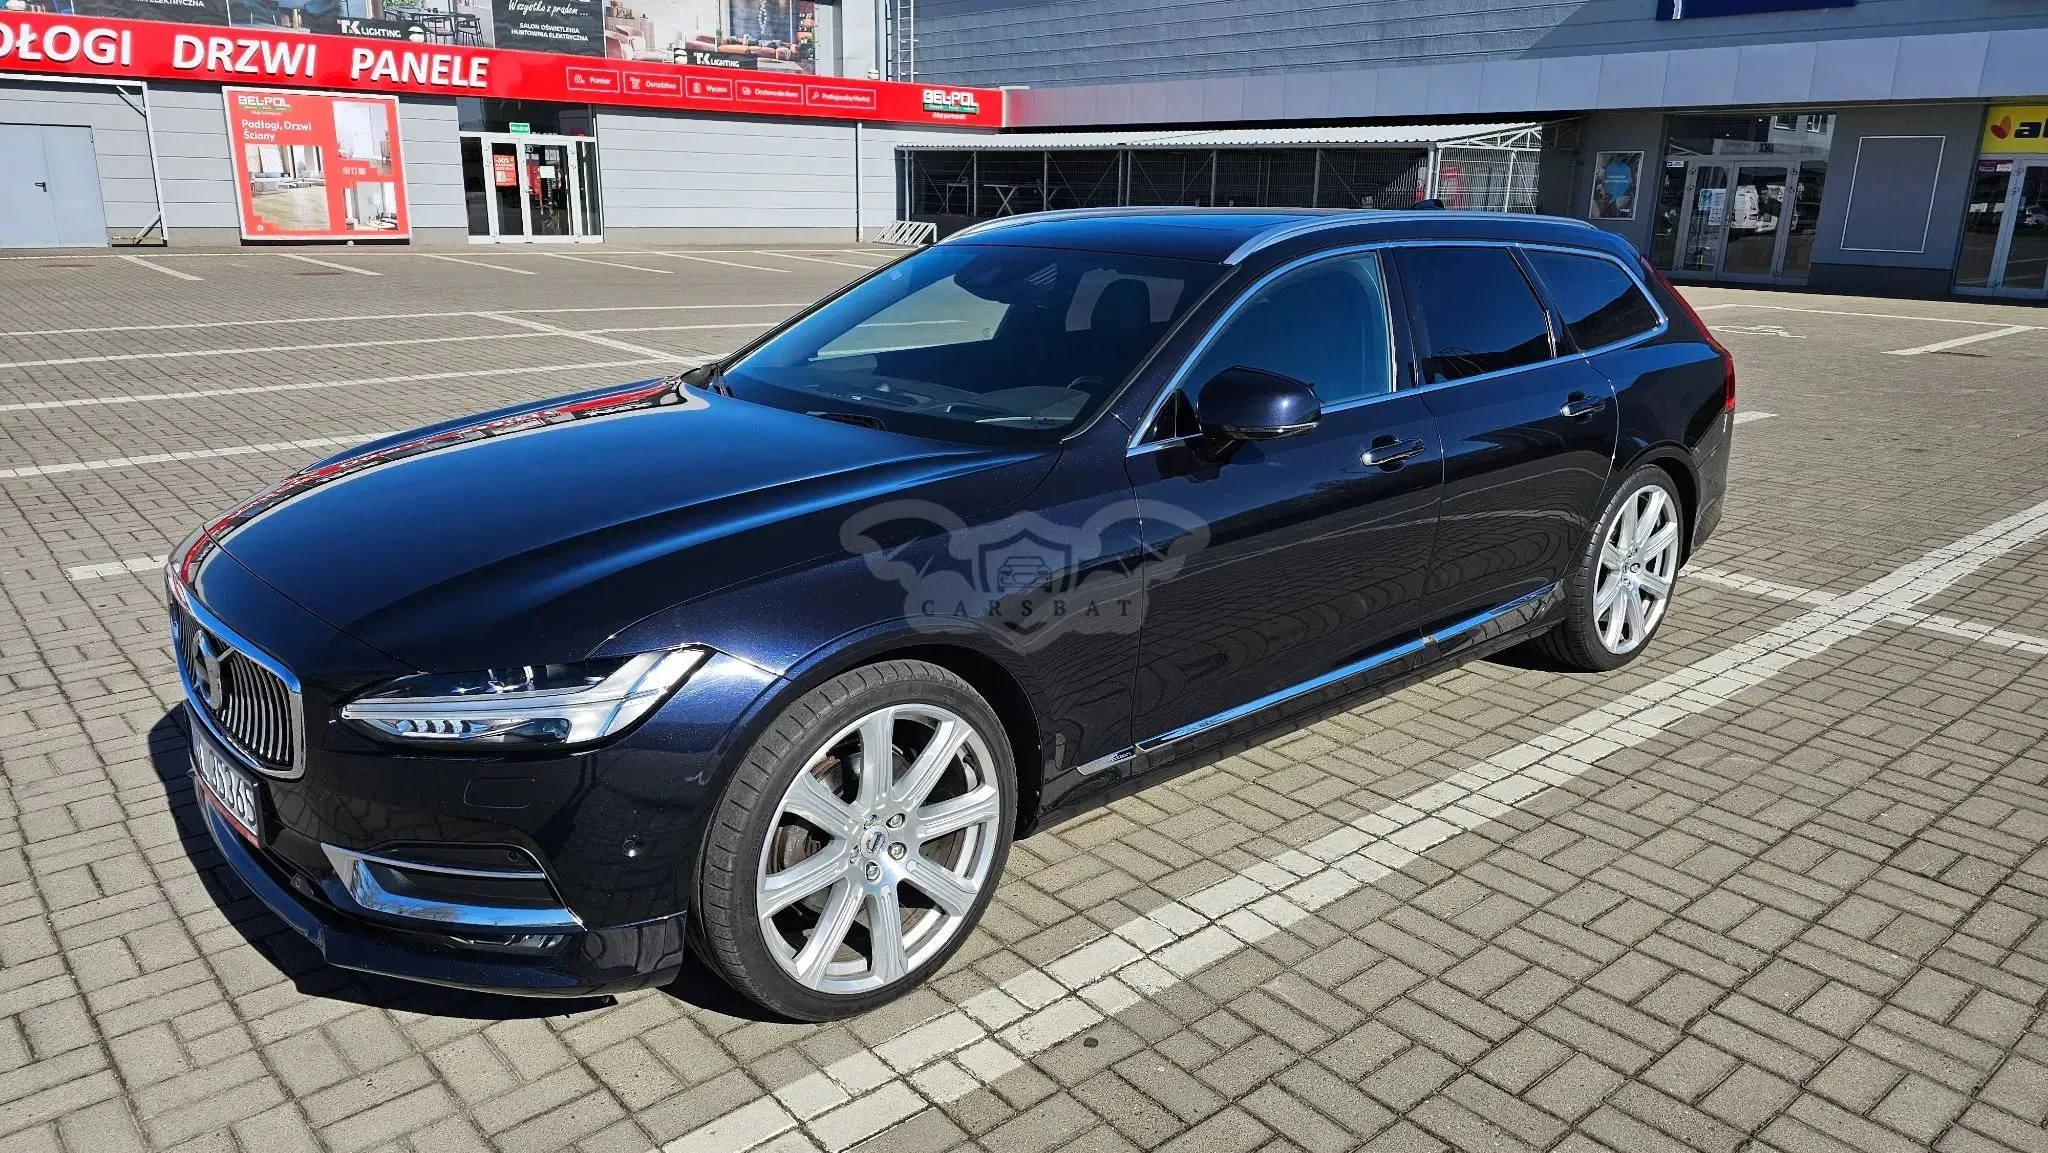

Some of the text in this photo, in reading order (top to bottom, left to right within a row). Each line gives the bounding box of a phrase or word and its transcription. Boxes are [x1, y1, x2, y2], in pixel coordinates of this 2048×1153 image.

[336, 19, 402, 38] TK LIGHTING
[511, 29, 589, 41] HURTOWNIA ELEKTRYCZNA
[541, 24, 580, 34] OŚWIETLENIA
[173, 35, 317, 78] DRZWI
[693, 52, 740, 68] TK LIGHTING
[350, 48, 490, 88] PANELE
[237, 95, 291, 108] BEL-POL
[923, 89, 979, 107] BEL-POL
[241, 119, 312, 131] Podłogi, Drzwi
[243, 128, 276, 141] Ściany
[208, 748, 257, 828] 35365
